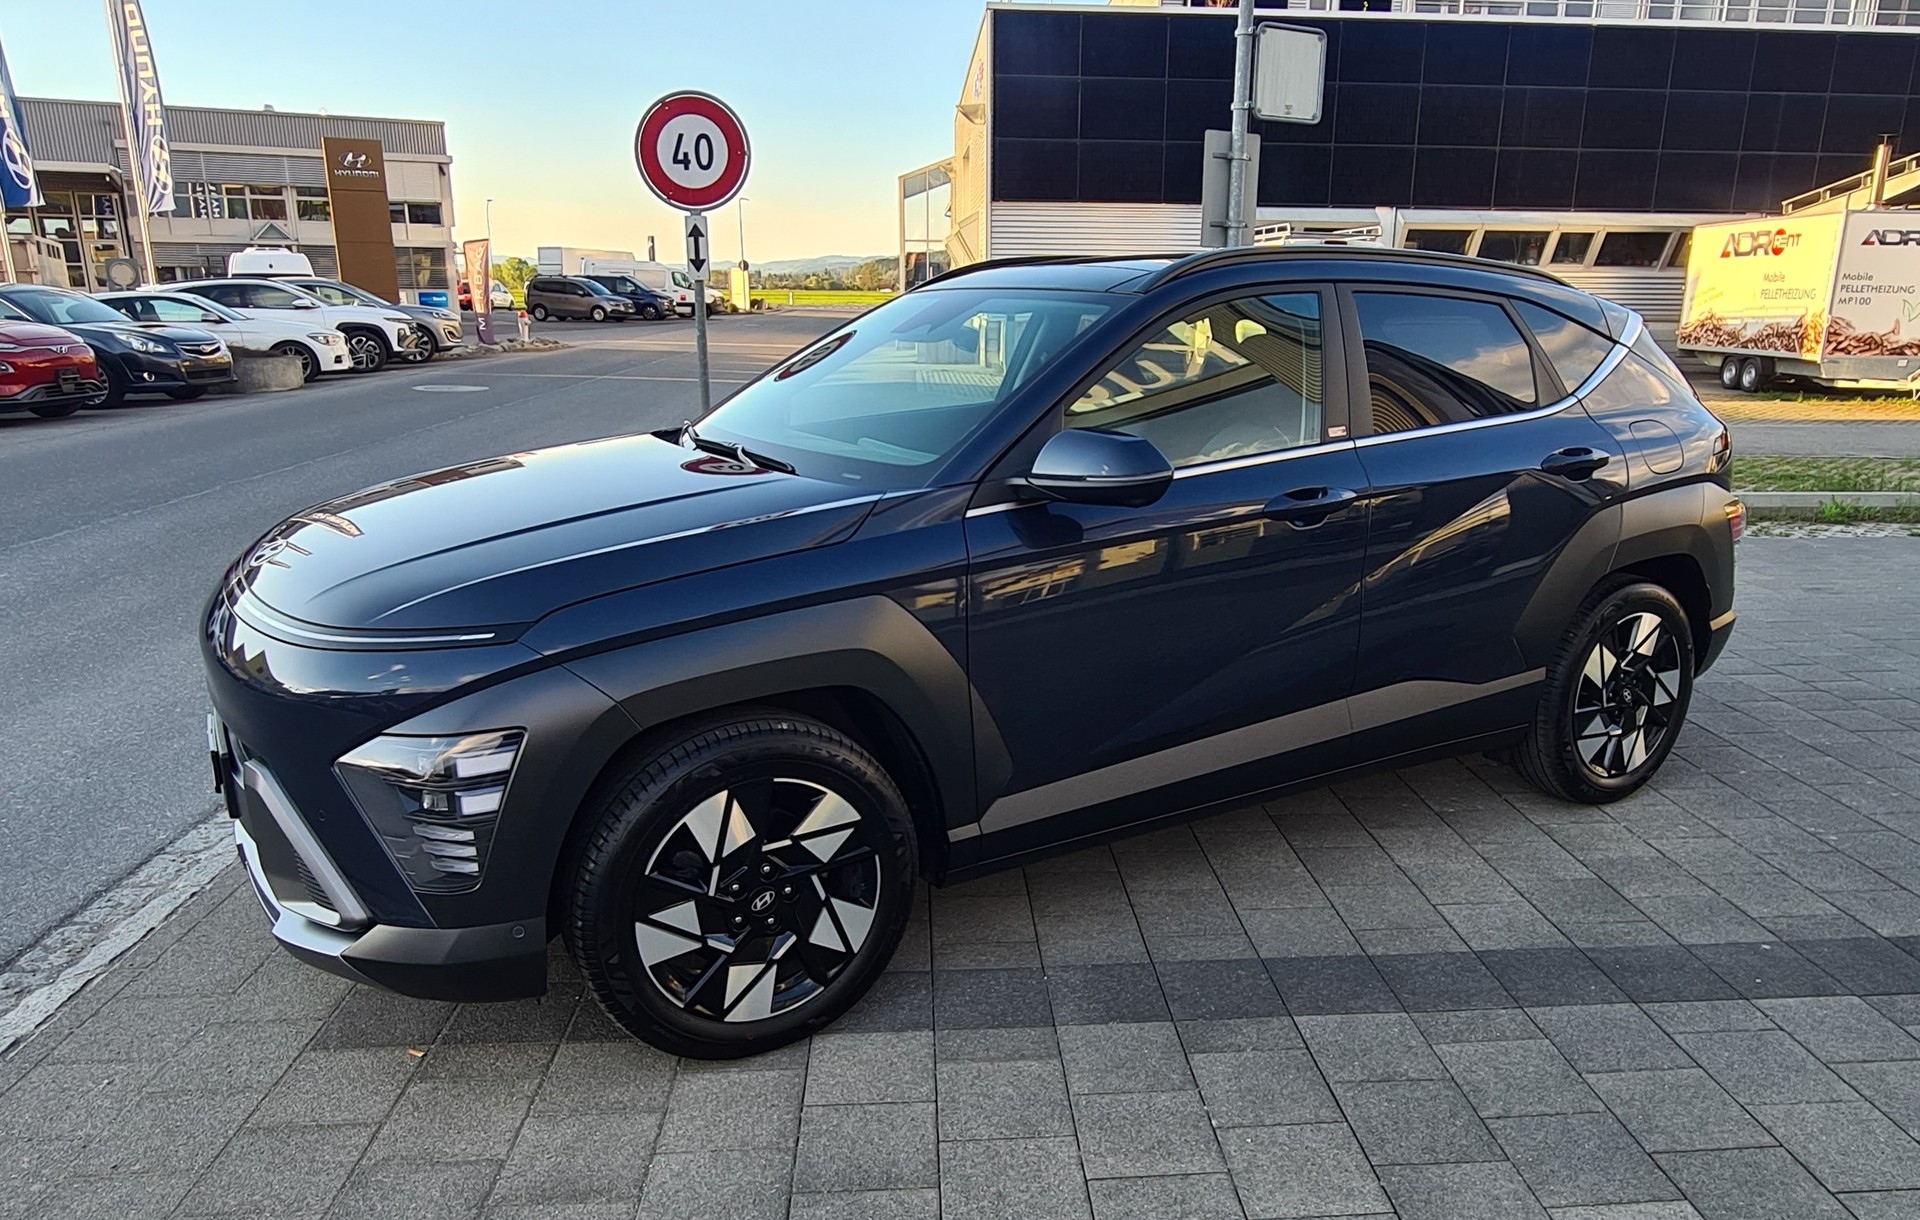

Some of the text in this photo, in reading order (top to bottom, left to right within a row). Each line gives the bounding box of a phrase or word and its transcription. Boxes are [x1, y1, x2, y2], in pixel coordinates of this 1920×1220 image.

[672, 133, 714, 171] 40
[334, 169, 380, 178] HYUNDAI
[1720, 230, 1771, 258] ADR
[1763, 272, 1786, 282] Mobile
[1842, 272, 1874, 281] Mobile
[473, 245, 487, 330] MERBAG
[1840, 284, 1916, 295] PELLETHEIZUNG
[1760, 288, 1817, 300] PELLETHEIZUNG
[1838, 297, 1872, 306] MP100
